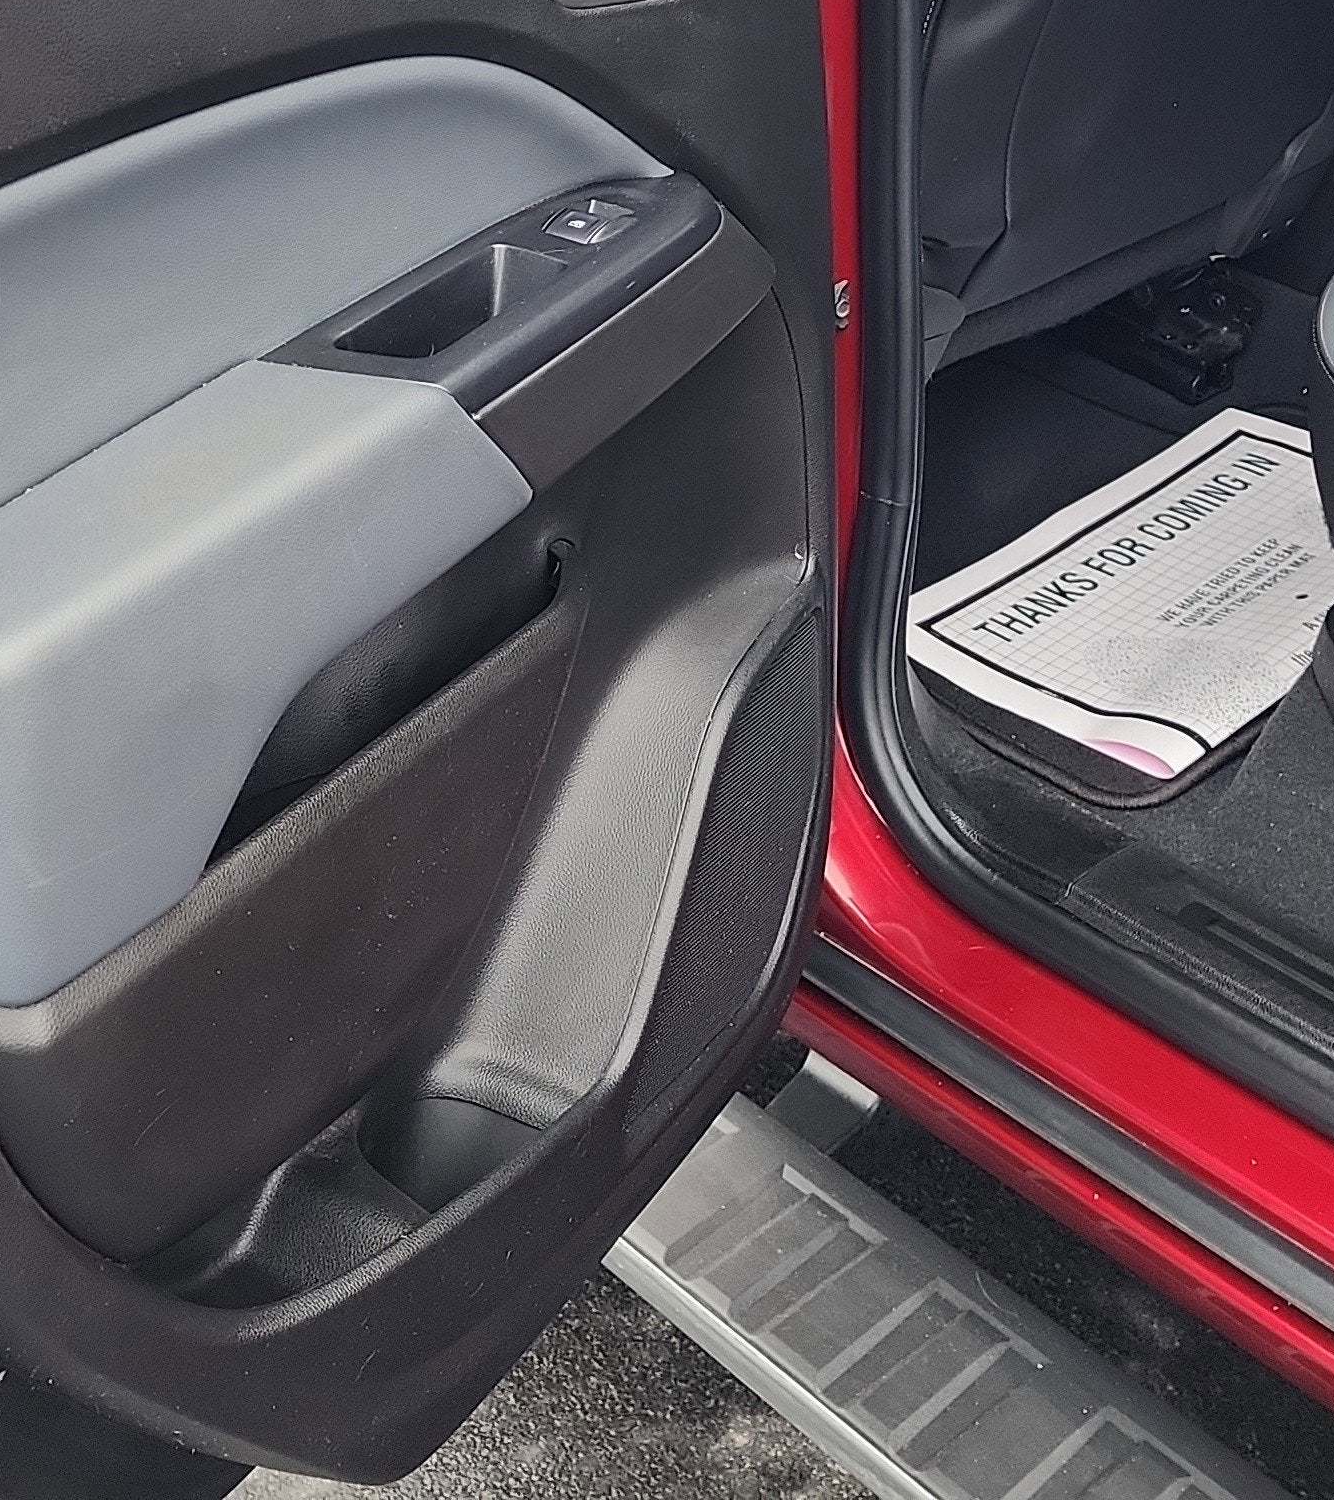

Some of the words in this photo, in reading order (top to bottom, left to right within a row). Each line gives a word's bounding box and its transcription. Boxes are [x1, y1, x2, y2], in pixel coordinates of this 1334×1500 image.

[972, 572, 1099, 642] THANKS
[1081, 537, 1155, 577] FOR
[1137, 473, 1252, 541] COMING
[1231, 452, 1281, 477] IN
[1156, 609, 1181, 622] WE
[1174, 588, 1211, 610] HAVE
[1204, 566, 1241, 590] TRIED
[1235, 556, 1256, 568] TO
[1250, 538, 1281, 557] KEEP
[1175, 605, 1212, 628] YOUR
[1206, 567, 1268, 607] CARPETING
[1265, 543, 1303, 568] CLEAN
[1200, 605, 1237, 627] WITH
[1231, 589, 1261, 608] THIS
[1255, 569, 1295, 592] PAPER
[1288, 552, 1317, 569] MAT
